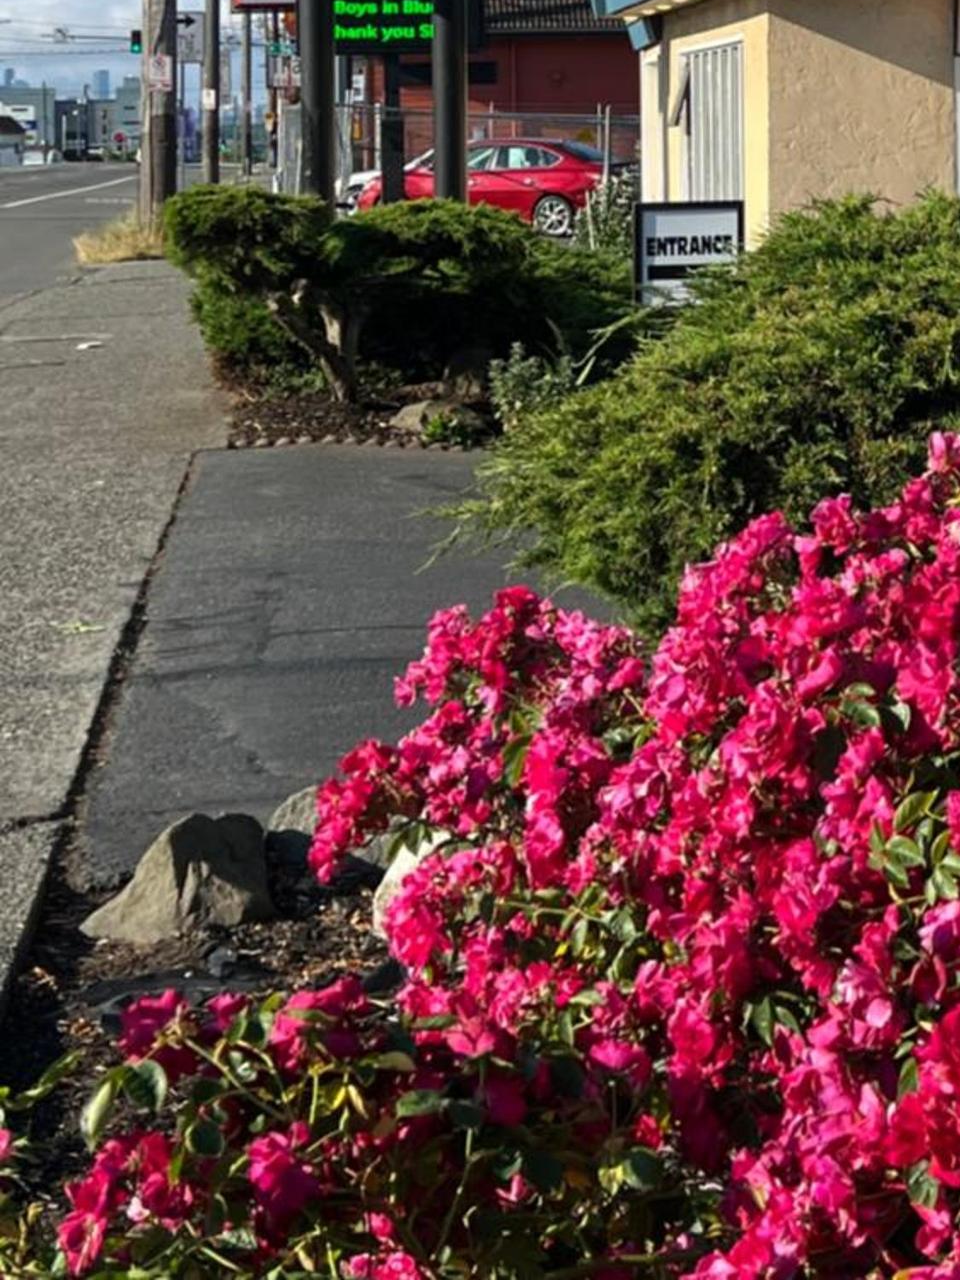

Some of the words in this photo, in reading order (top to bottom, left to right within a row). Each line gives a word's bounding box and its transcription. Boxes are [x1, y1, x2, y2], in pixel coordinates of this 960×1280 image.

[334, 0, 378, 17] Boys
[382, 0, 399, 14] in
[403, 0, 434, 15] Blu
[334, 24, 378, 39] hank
[380, 26, 416, 42] you
[645, 234, 734, 257] ENTRANCE
